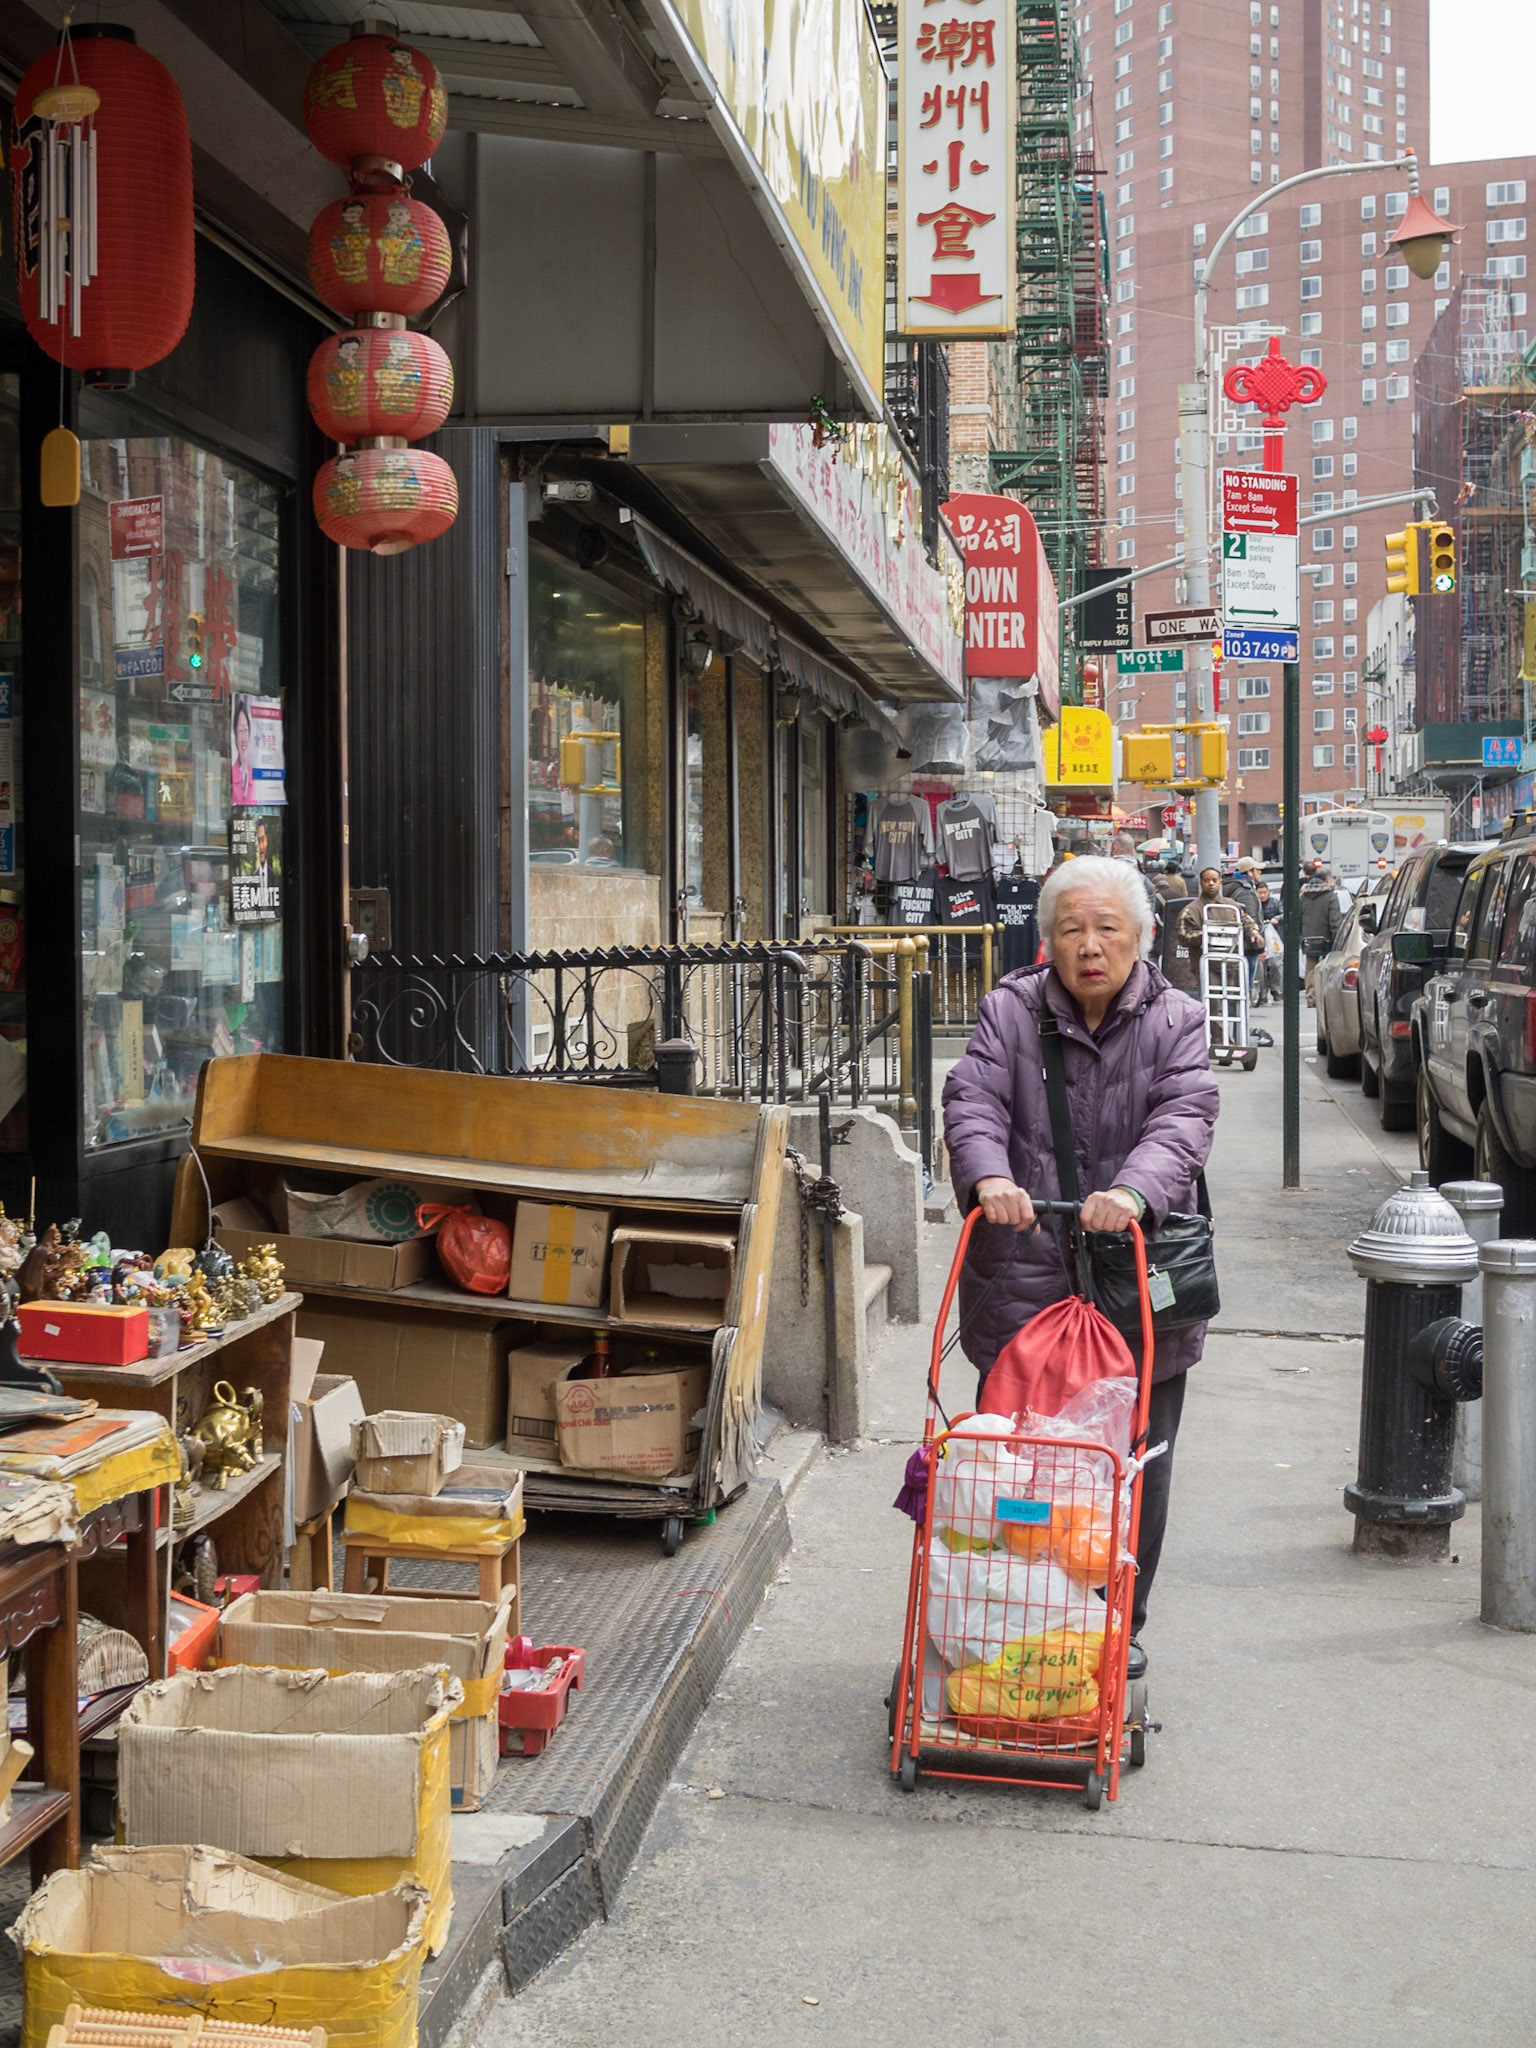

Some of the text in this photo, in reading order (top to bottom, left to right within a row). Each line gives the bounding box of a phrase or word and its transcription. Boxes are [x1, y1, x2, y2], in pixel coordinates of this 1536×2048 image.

[917, 0, 995, 260] 潮州小食
[1226, 475, 1287, 492] NO STANDING
[1227, 490, 1242, 500] 7am
[1248, 492, 1263, 502] 8am
[1226, 502, 1277, 516] Except Sunday
[1228, 534, 1241, 557] 2
[1249, 544, 1274, 553] metered
[1249, 554, 1272, 564] parking
[1227, 568, 1242, 578] 8am
[1248, 570, 1266, 580] 10pm
[1227, 579, 1276, 593] Except Sunday
[966, 612, 1026, 648] NTER
[1159, 620, 1186, 634] ONE
[1122, 652, 1163, 665] Mott
[881, 821, 896, 832] NEW
[945, 823, 960, 835] NEW
[888, 831, 908, 844] CITY
[955, 828, 974, 840] CITY
[901, 899, 931, 912] FUCKIN
[906, 912, 925, 924] CITY
[1176, 950, 1189, 958] BIG
[570, 1399, 590, 1408] ABC
